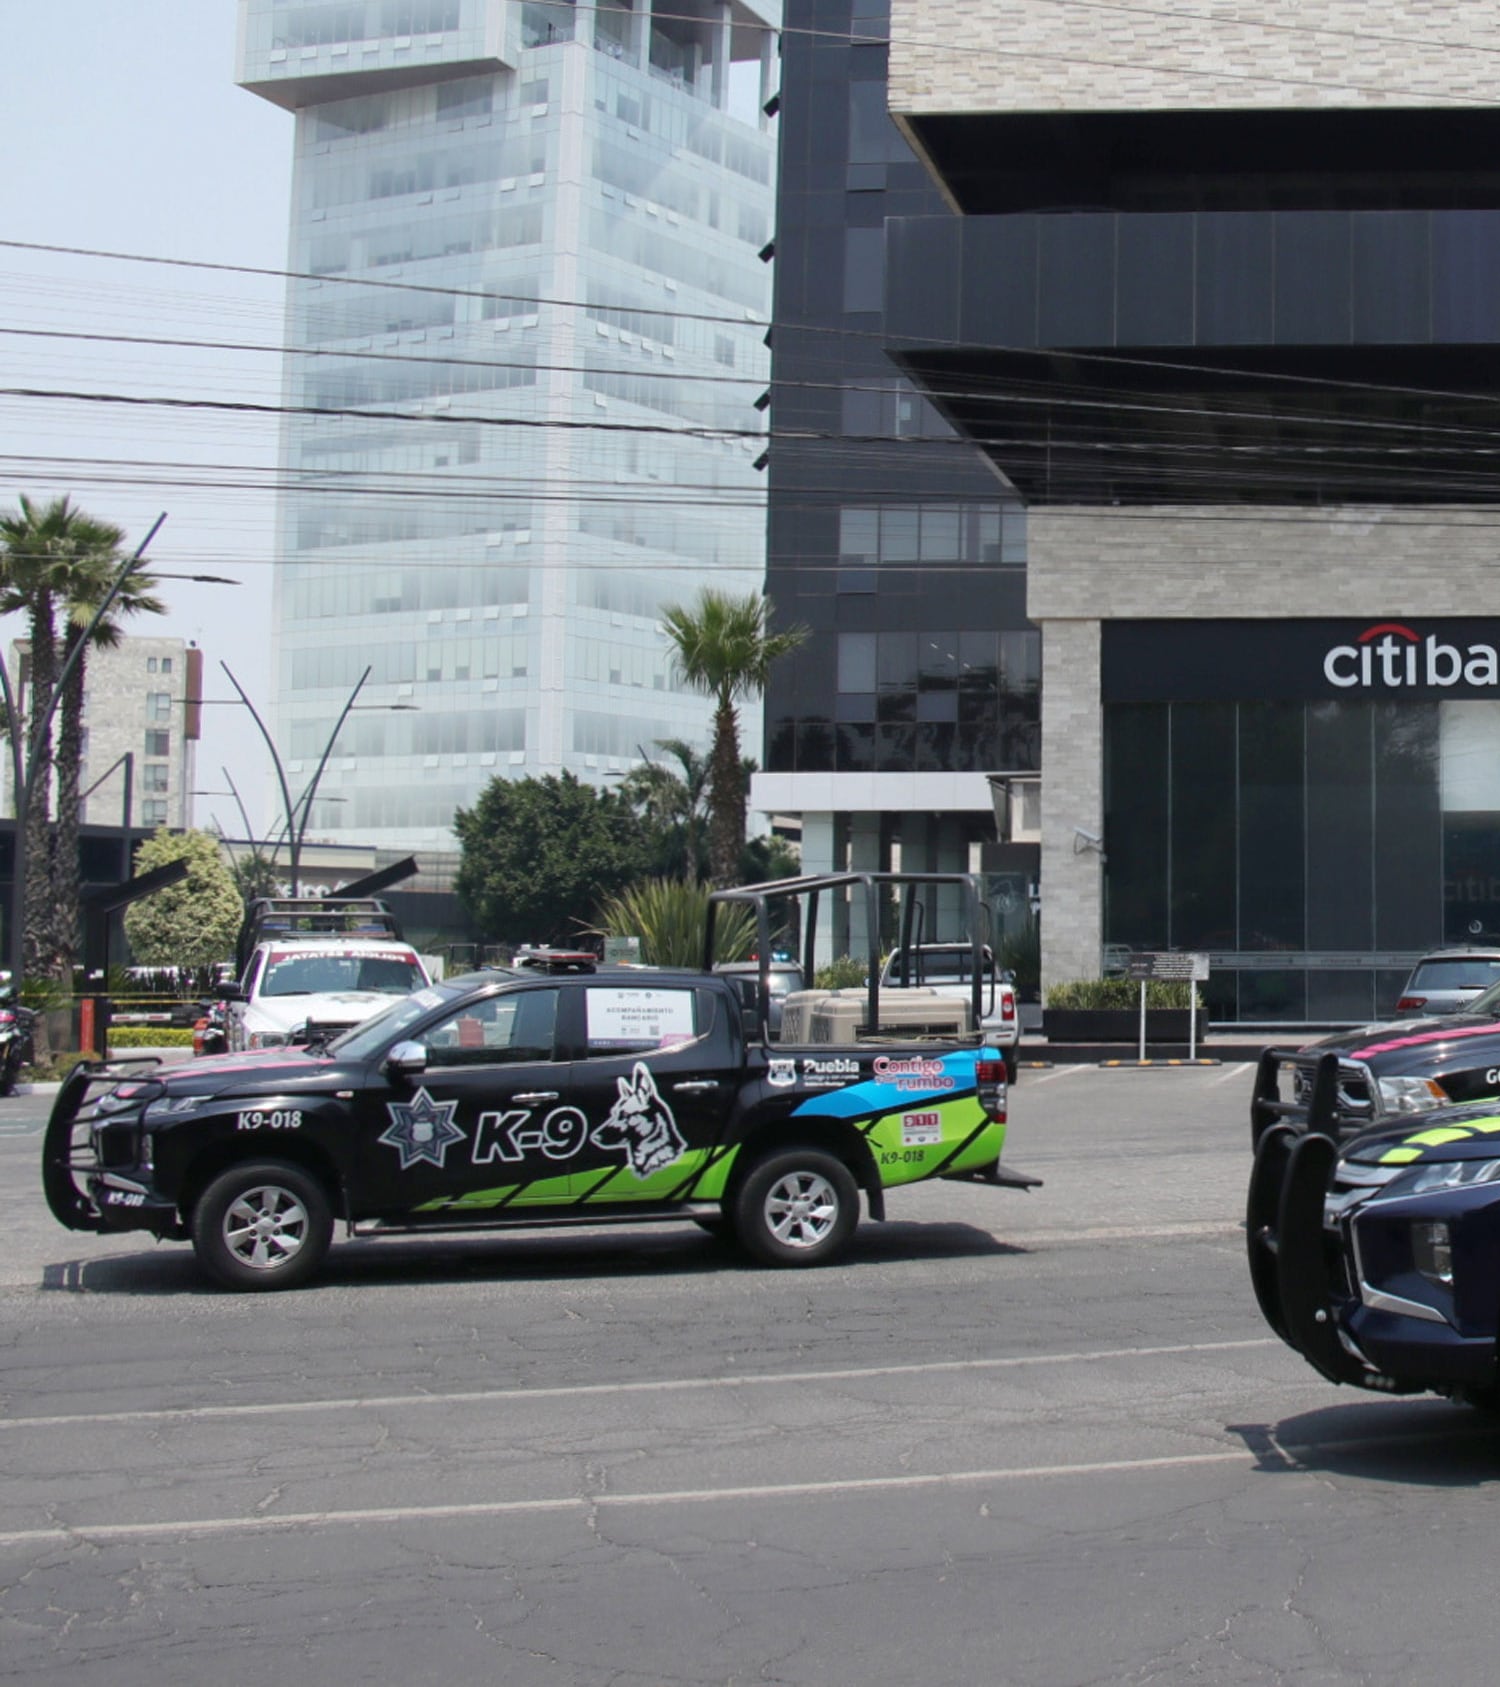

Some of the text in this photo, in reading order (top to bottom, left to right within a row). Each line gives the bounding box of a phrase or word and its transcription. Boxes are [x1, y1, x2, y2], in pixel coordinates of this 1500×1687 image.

[803, 1058, 860, 1073] Puebla
[873, 1056, 944, 1076] Contigo
[896, 1076, 955, 1091] rumbo
[237, 1110, 302, 1129] K9-018
[904, 1114, 938, 1127] 911
[471, 1105, 588, 1164] K-9
[881, 1150, 925, 1165] K9-018
